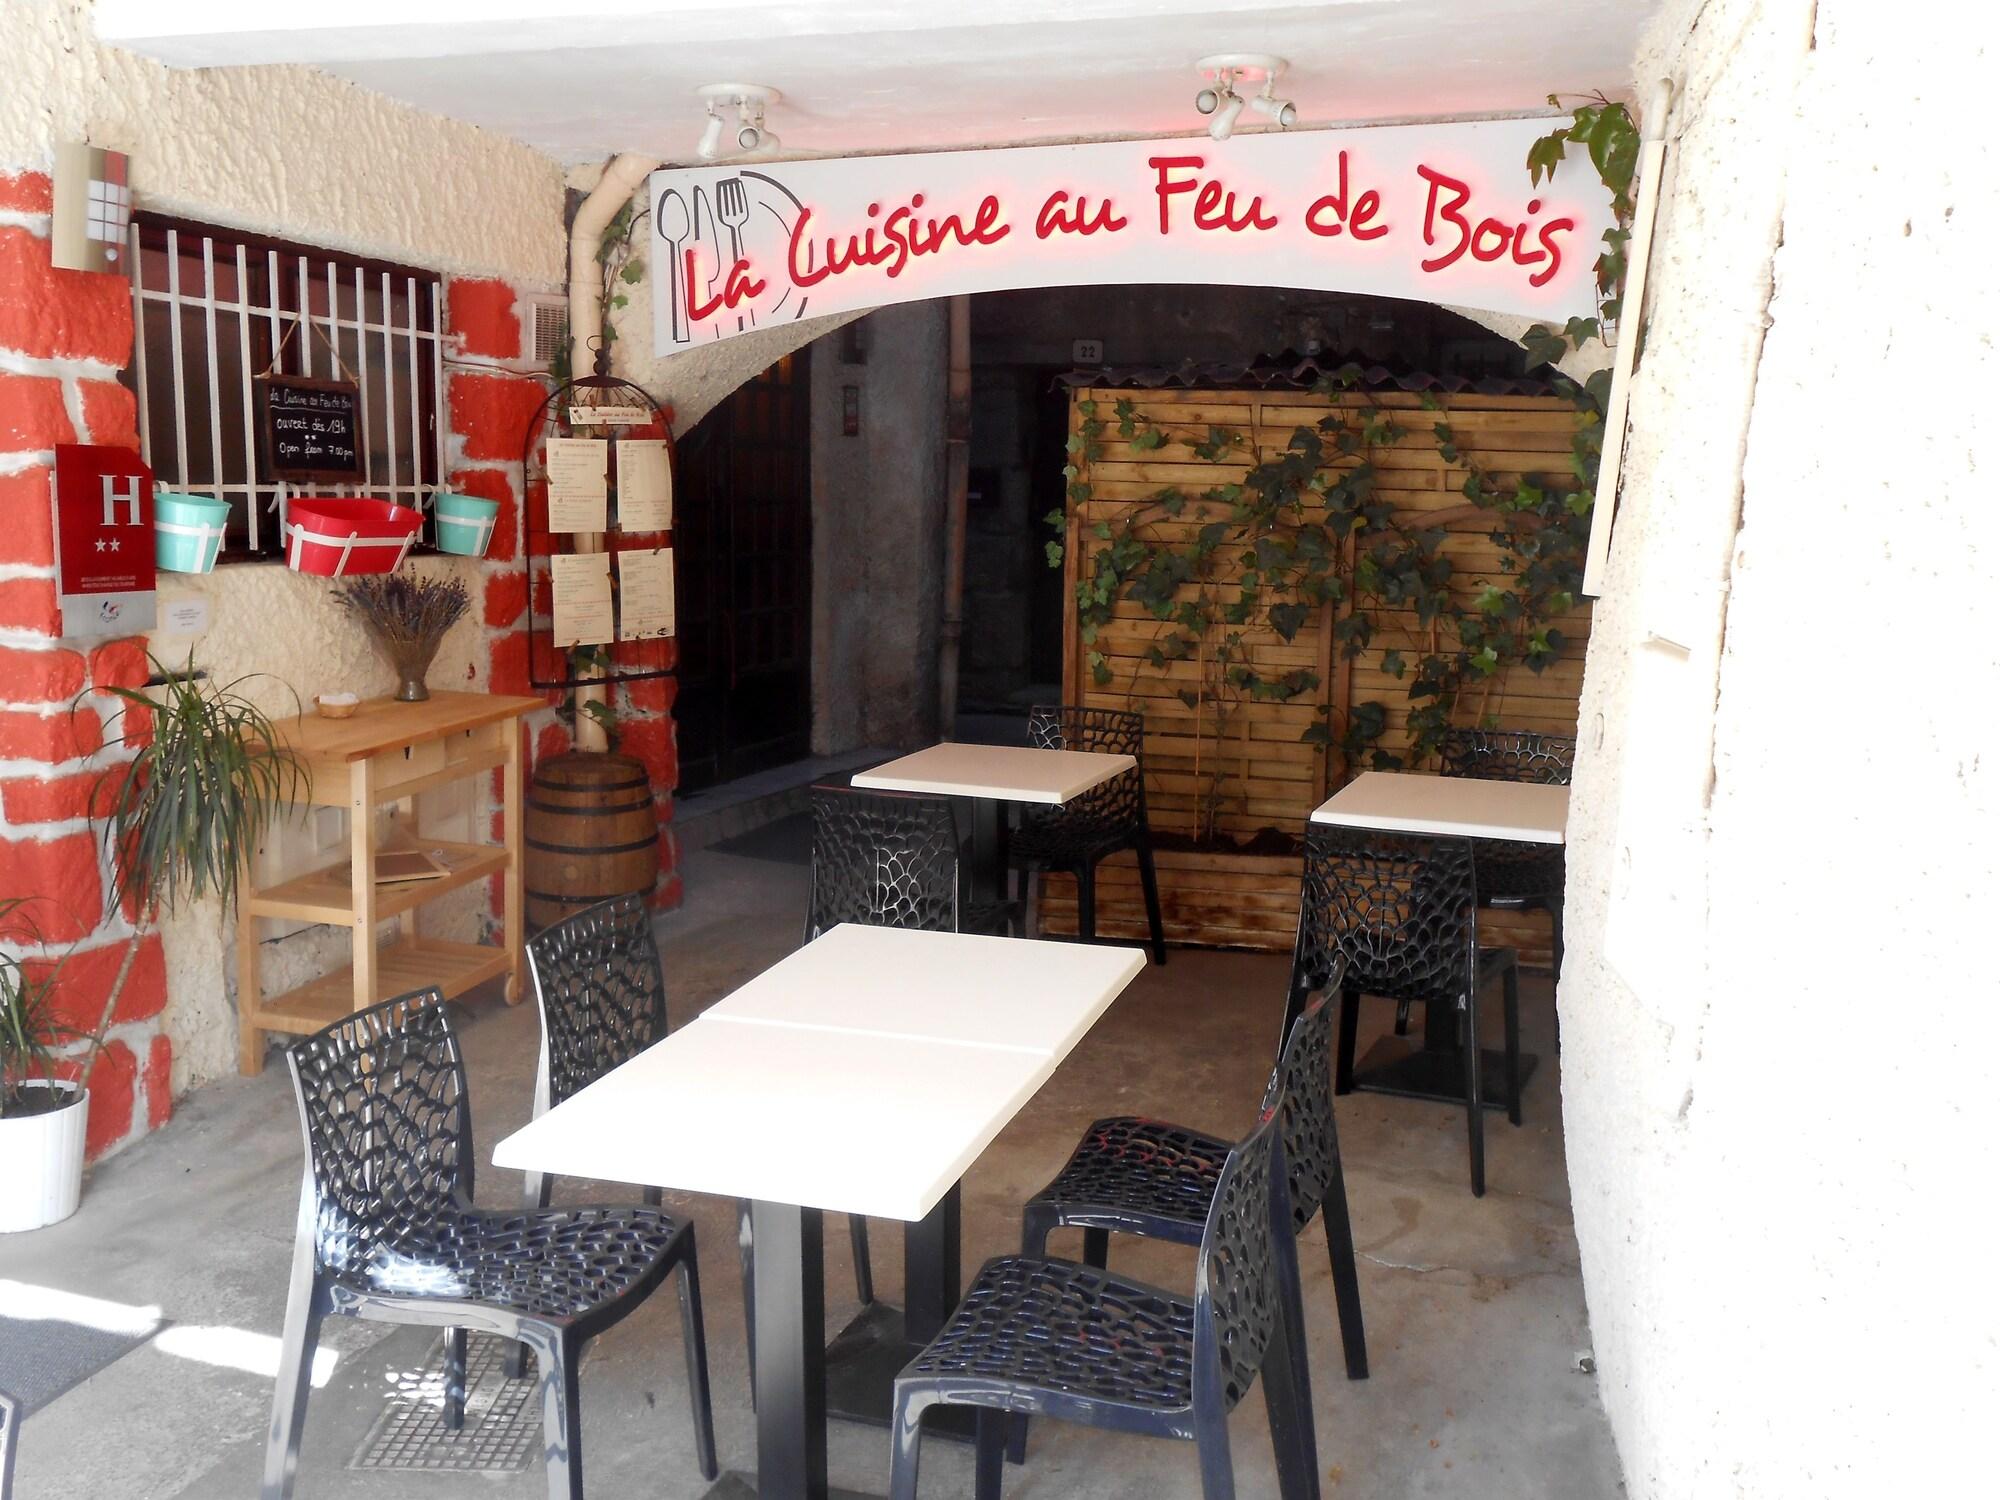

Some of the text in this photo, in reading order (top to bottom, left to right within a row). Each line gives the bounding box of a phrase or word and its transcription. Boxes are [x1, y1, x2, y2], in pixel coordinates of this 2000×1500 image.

[685, 150, 1575, 321] La Cuisine au Feu de Bois
[1081, 345, 1096, 358] 22
[279, 442, 299, 458] Open
[98, 474, 145, 526] H
